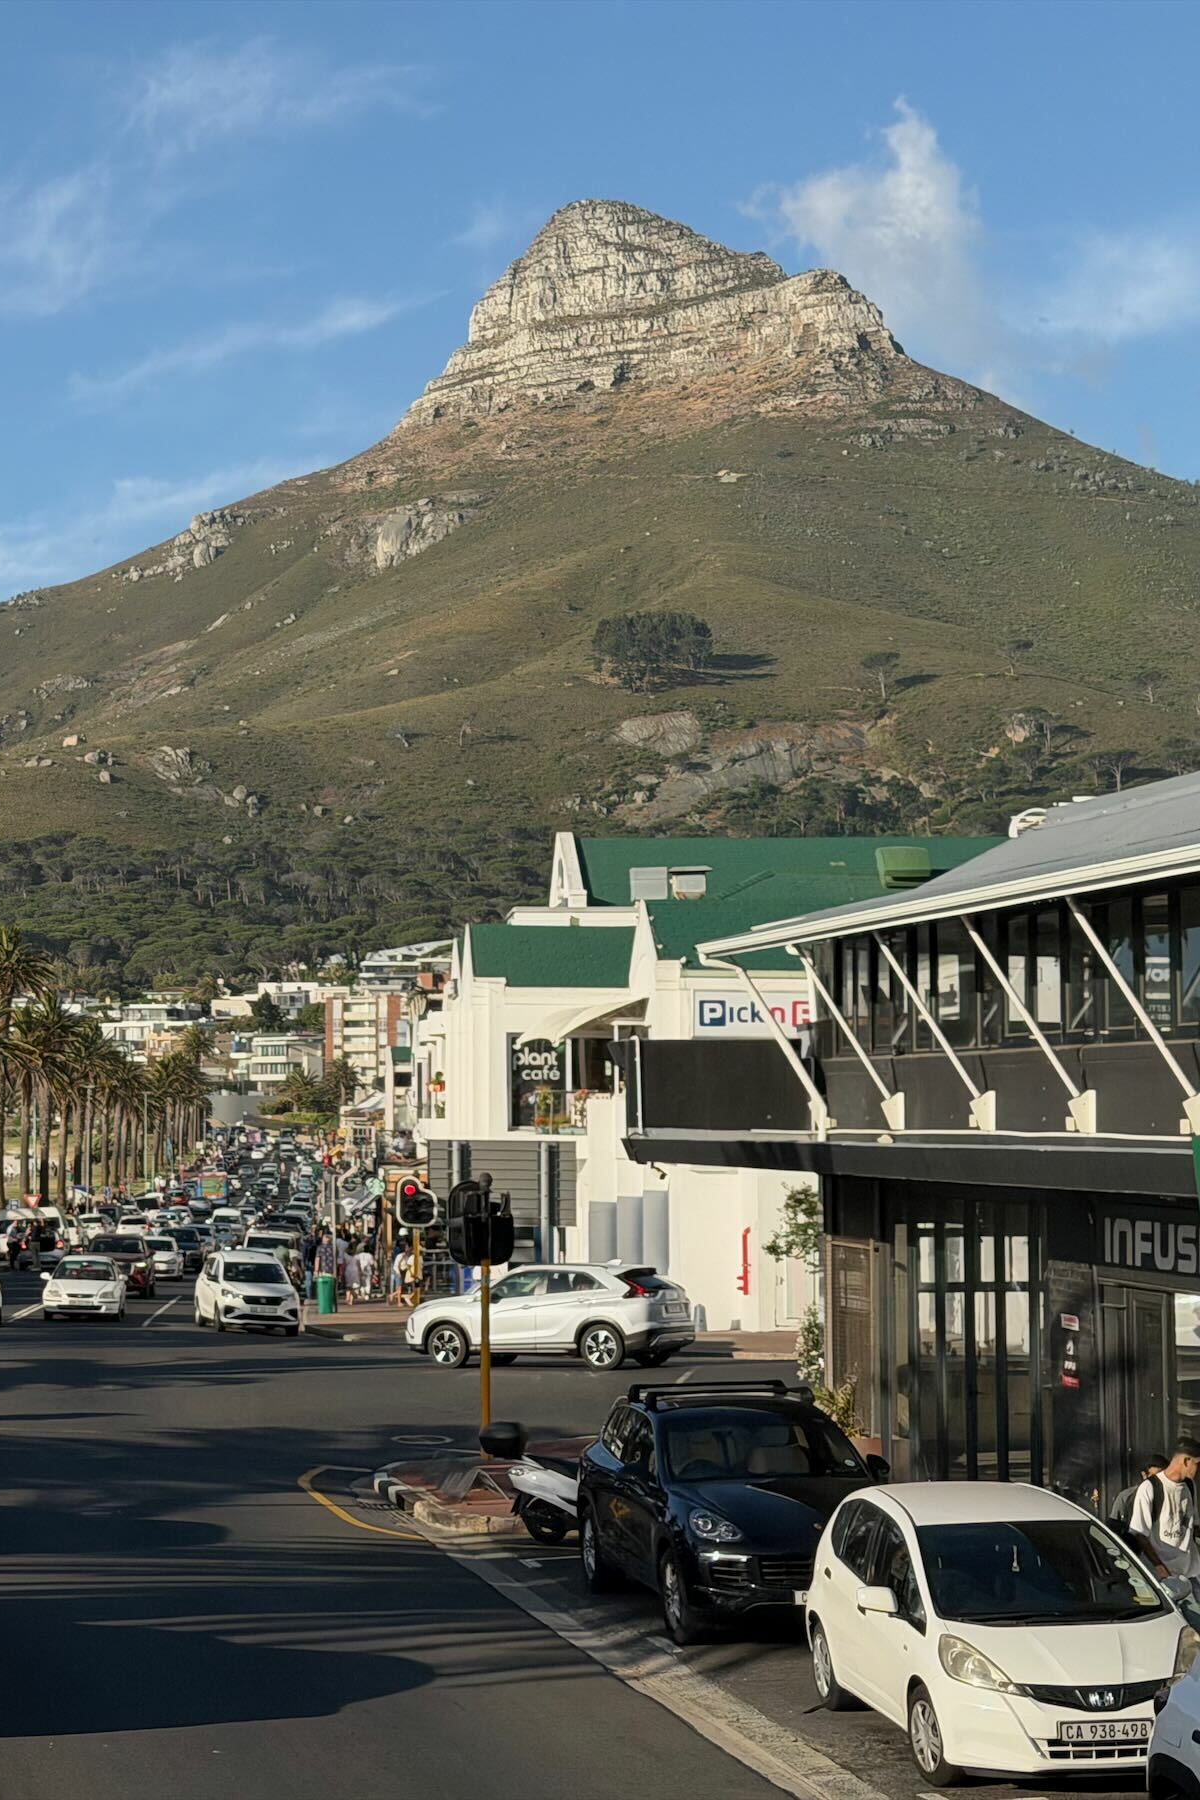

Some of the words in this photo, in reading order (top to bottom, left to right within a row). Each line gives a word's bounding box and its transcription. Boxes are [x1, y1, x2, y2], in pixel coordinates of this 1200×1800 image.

[700, 1000, 764, 1025] Pick
[771, 1007, 786, 1023] n
[513, 1046, 558, 1070] plant
[521, 1065, 560, 1080] café
[1104, 1217, 1200, 1274] INFUS
[1066, 1725, 1084, 1739] CA
[1090, 1723, 1148, 1739] 938-498
